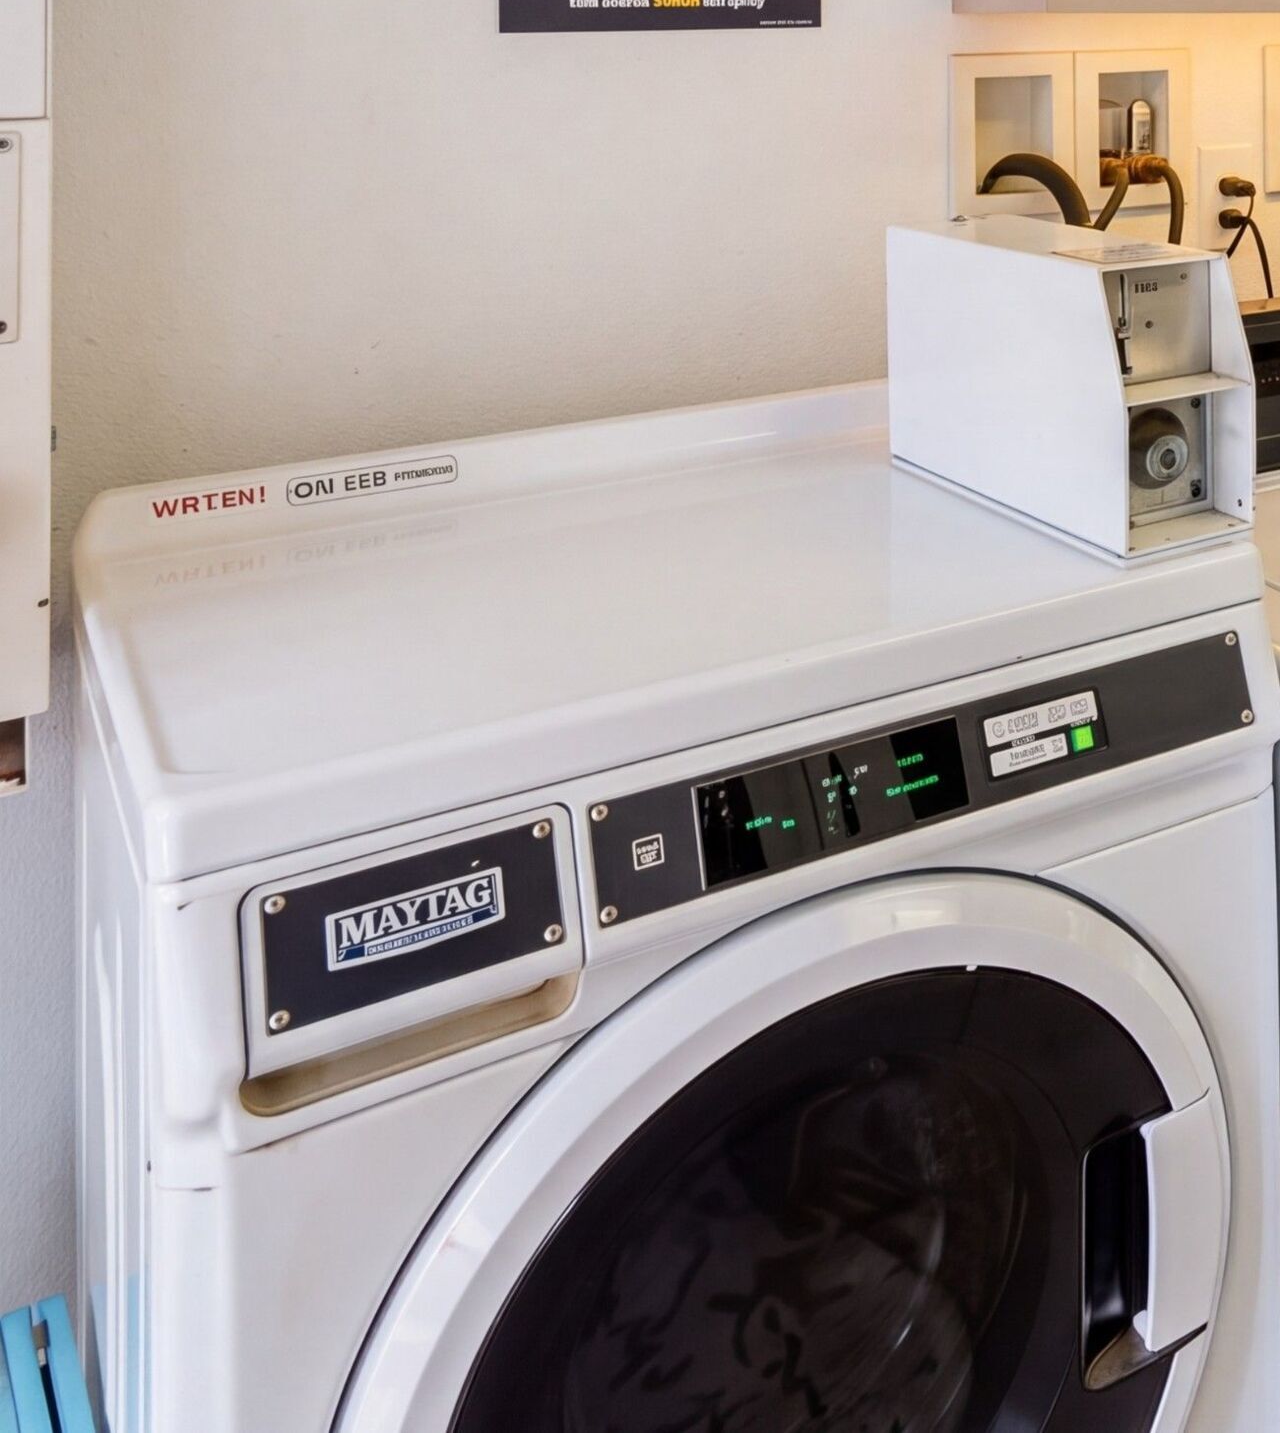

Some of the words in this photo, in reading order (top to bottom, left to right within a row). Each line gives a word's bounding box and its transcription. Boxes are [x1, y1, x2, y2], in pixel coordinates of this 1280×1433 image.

[344, 471, 387, 492] EEB
[153, 486, 267, 518] WRTEN!
[339, 877, 493, 949] MAYTAG
